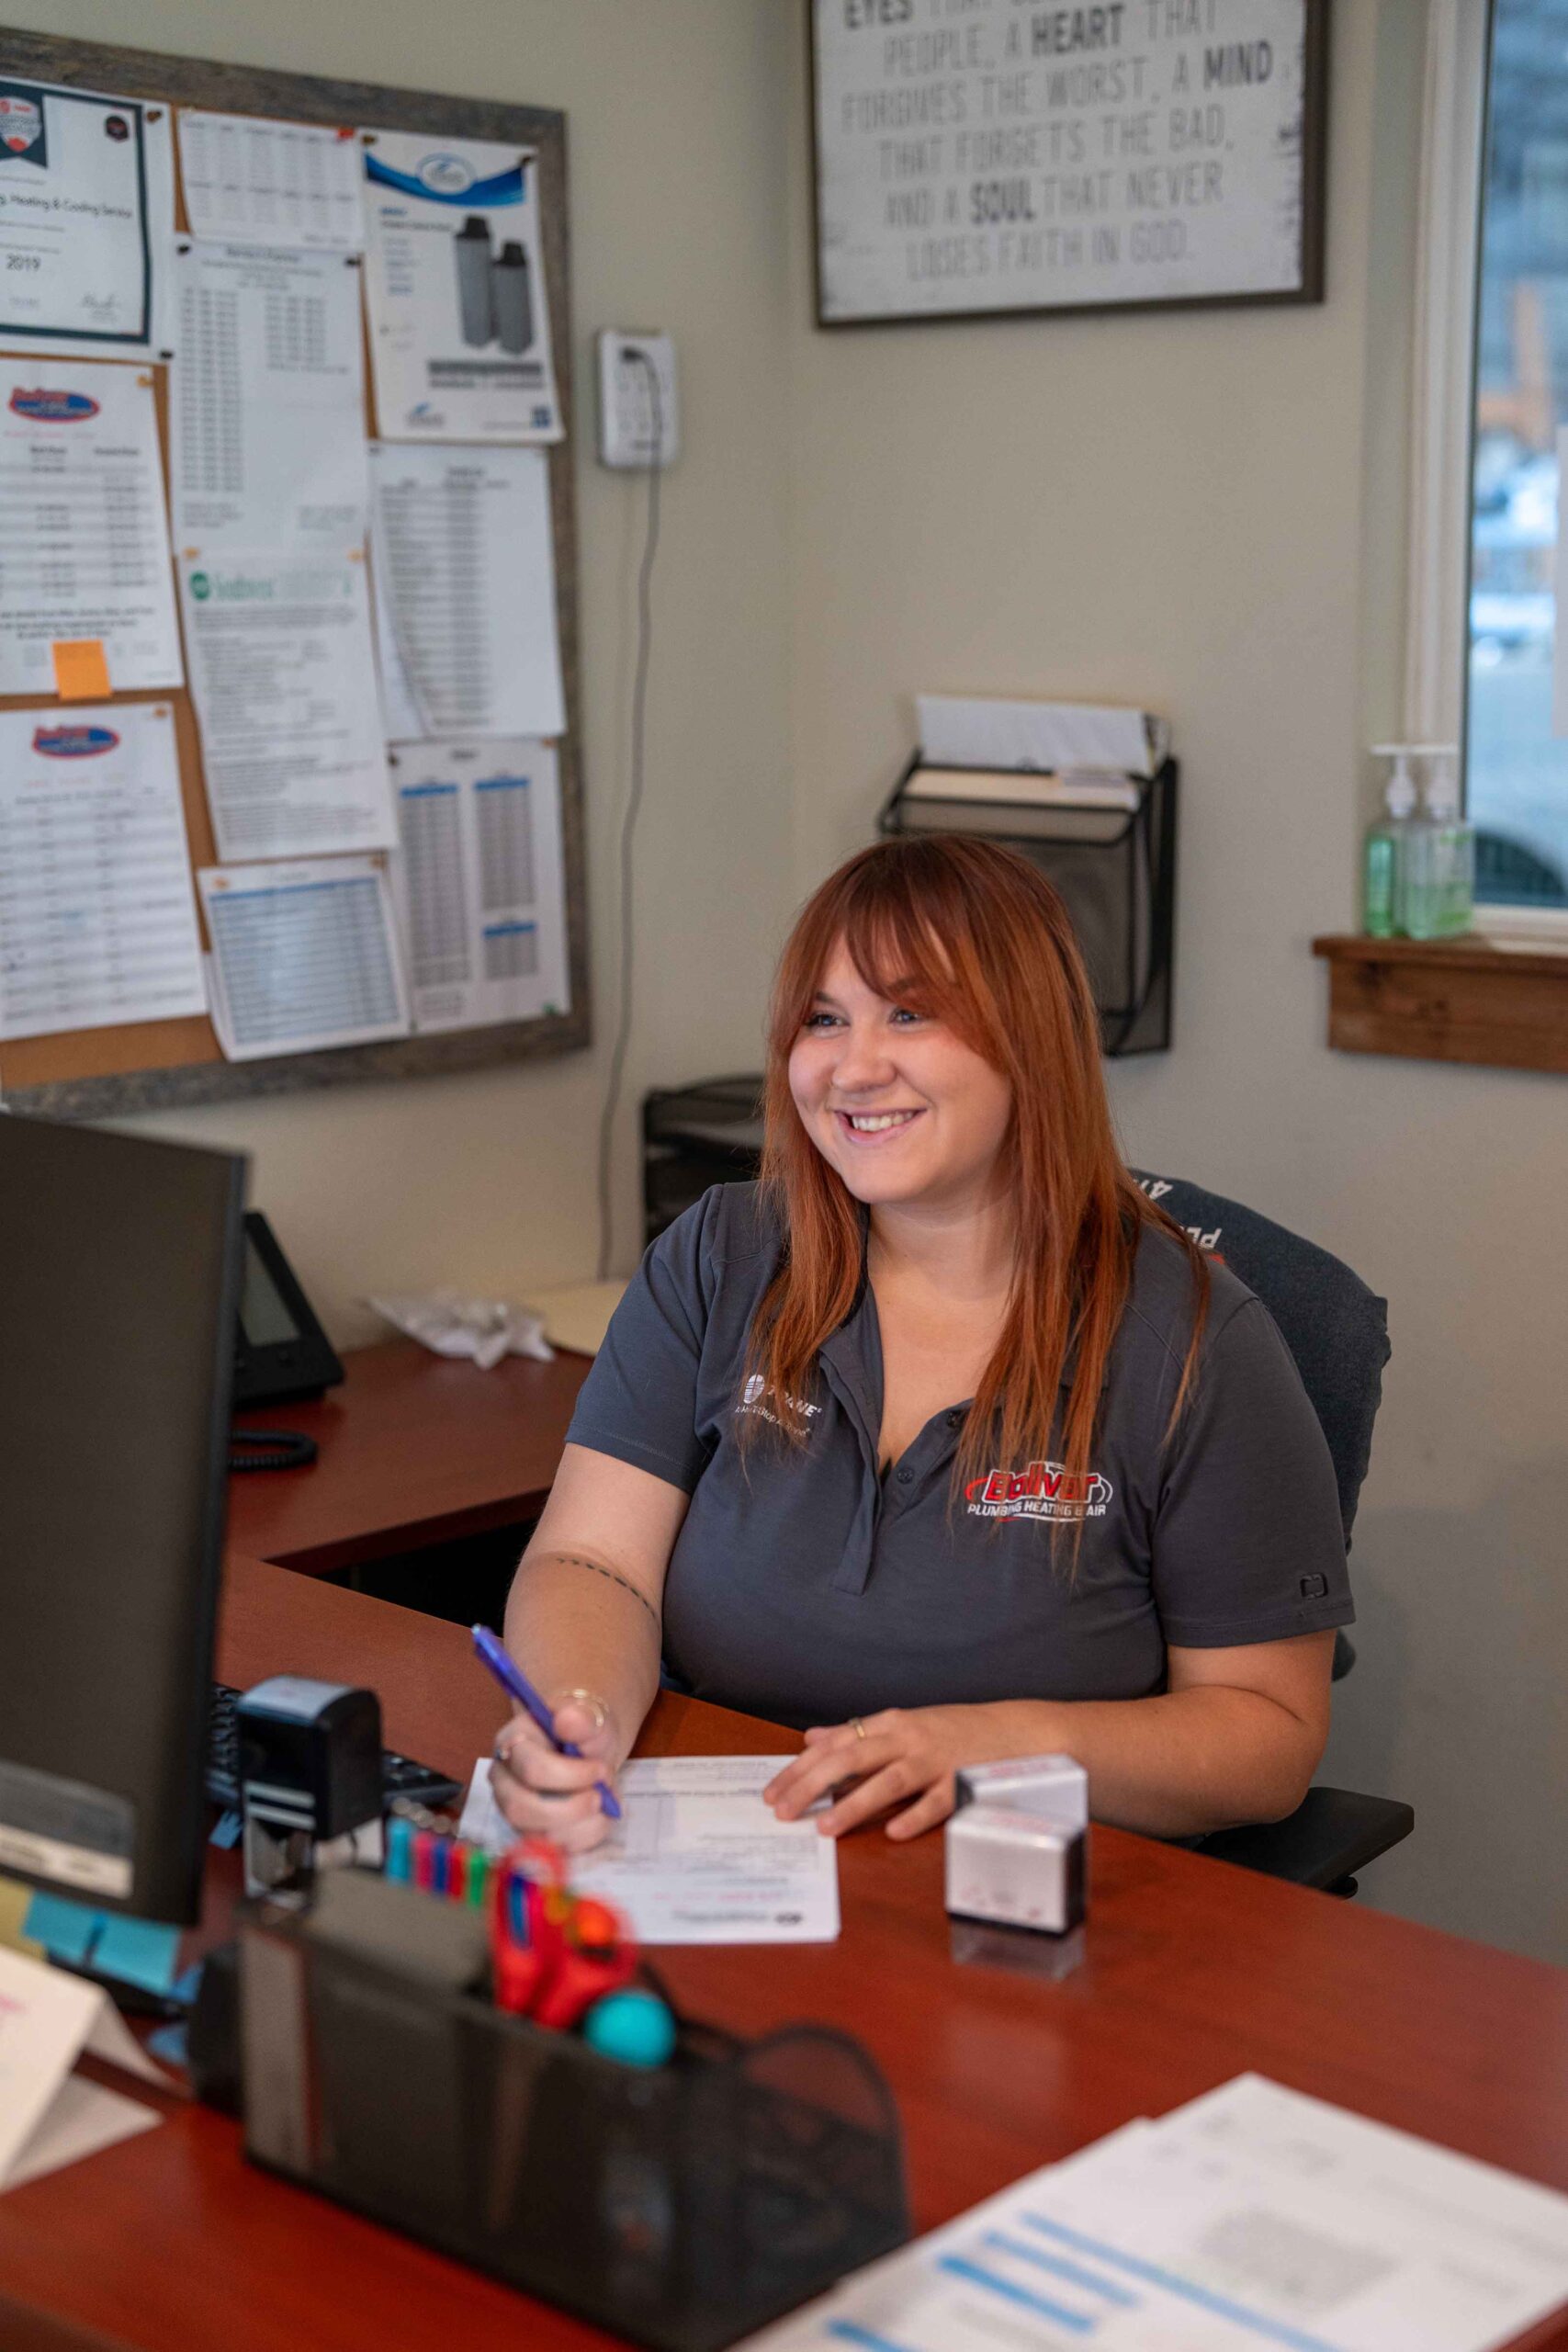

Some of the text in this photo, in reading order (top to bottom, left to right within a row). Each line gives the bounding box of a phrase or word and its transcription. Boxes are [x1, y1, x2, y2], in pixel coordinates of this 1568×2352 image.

[844, 0, 913, 29] EYES
[1005, 20, 1021, 59] A
[1031, 4, 1123, 57] HEART
[1148, 0, 1216, 40] THAT
[841, 80, 966, 134] FORGIVES
[980, 71, 1032, 117] THE
[1171, 52, 1190, 92] A
[1203, 39, 1273, 90] MIND
[879, 135, 944, 181] THAT
[955, 121, 1086, 173] FORGETS
[1103, 111, 1156, 156] THE
[885, 160, 1223, 229] AND A SOUL THAT NEVER
[6, 254, 41, 271] 2019
[907, 234, 992, 282] LOSES
[998, 225, 1085, 272] FAITH
[1092, 223, 1121, 265] IN
[967, 1501, 1022, 1517] PLUMBING
[1023, 1500, 1071, 1517] HEATING
[1086, 1504, 1106, 1517] AIR
